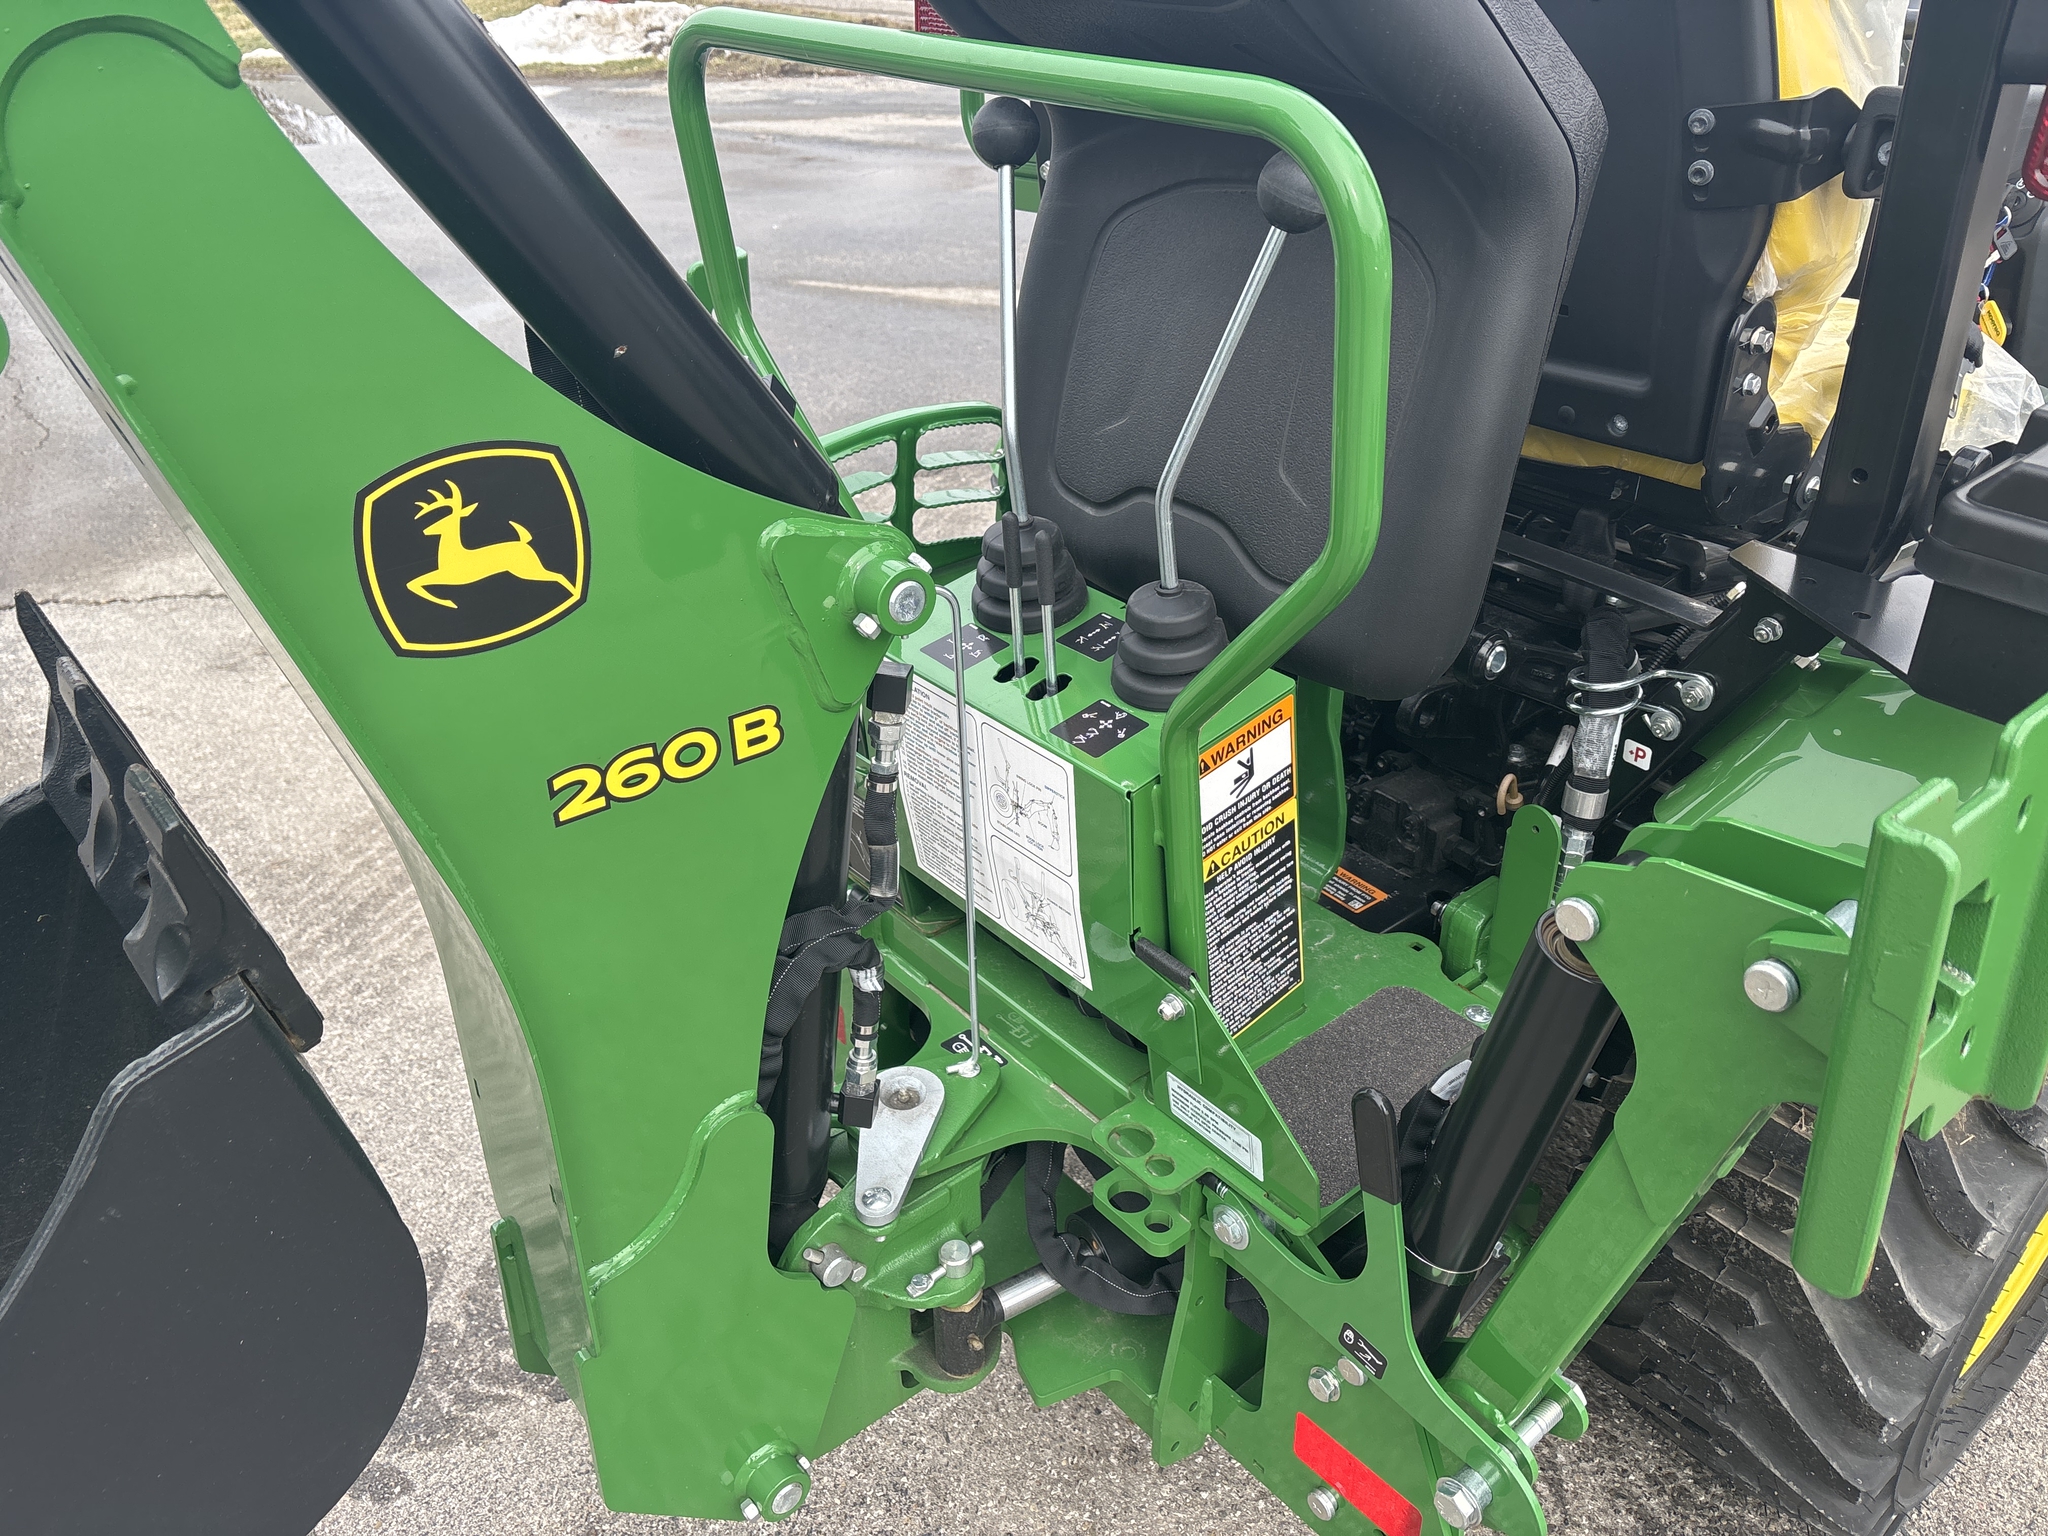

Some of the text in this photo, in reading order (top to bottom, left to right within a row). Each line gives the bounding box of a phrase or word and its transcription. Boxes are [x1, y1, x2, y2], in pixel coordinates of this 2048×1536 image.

[547, 704, 785, 828] 260 B
[1210, 708, 1284, 767] WARNING
[1201, 767, 1291, 834] OID CRUSH INJURY OR DEATH
[1216, 836, 1275, 882] HELP AVOID INJURY
[1221, 811, 1285, 867] CAUTION
[1340, 872, 1375, 894] WARNING
